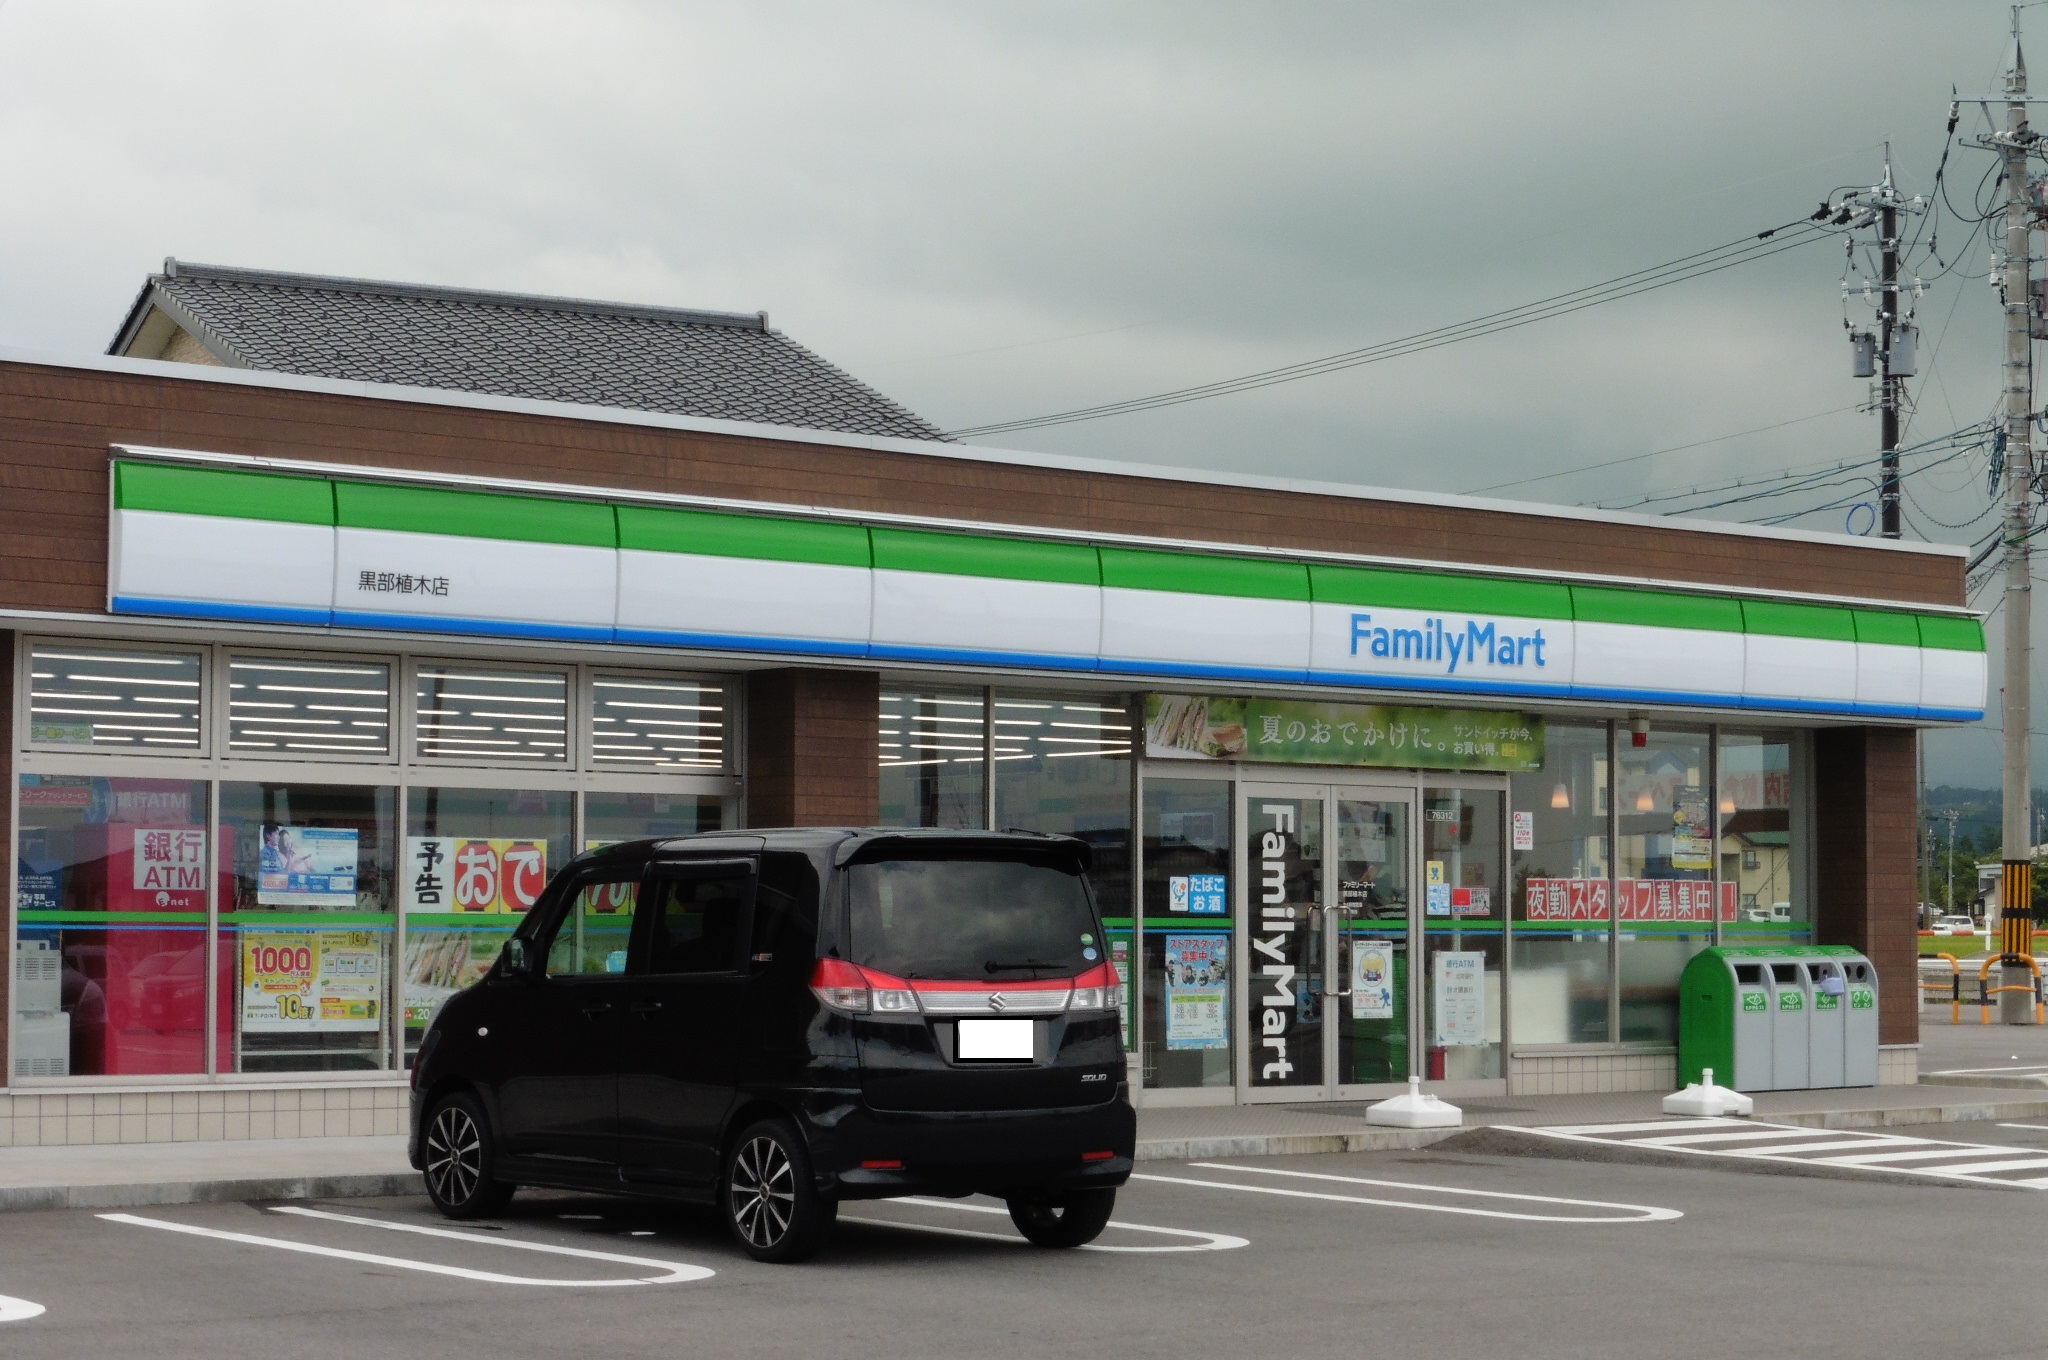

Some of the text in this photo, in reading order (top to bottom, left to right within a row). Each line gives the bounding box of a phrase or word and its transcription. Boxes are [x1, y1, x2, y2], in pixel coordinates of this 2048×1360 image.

[359, 571, 449, 596] 黒部植木店
[1351, 613, 1546, 673] FamilyMart
[1259, 715, 1446, 752] 夏のおでかけに。
[144, 832, 202, 863] 銀行
[143, 867, 200, 888] ATM
[415, 842, 444, 904] 予告
[1190, 876, 1224, 892] たばこ
[1342, 881, 1376, 889] ファミリーマート
[1193, 895, 1221, 911] お酒
[1170, 939, 1225, 950] ストアスタッフ
[1254, 804, 1295, 1079] FamilyMart
